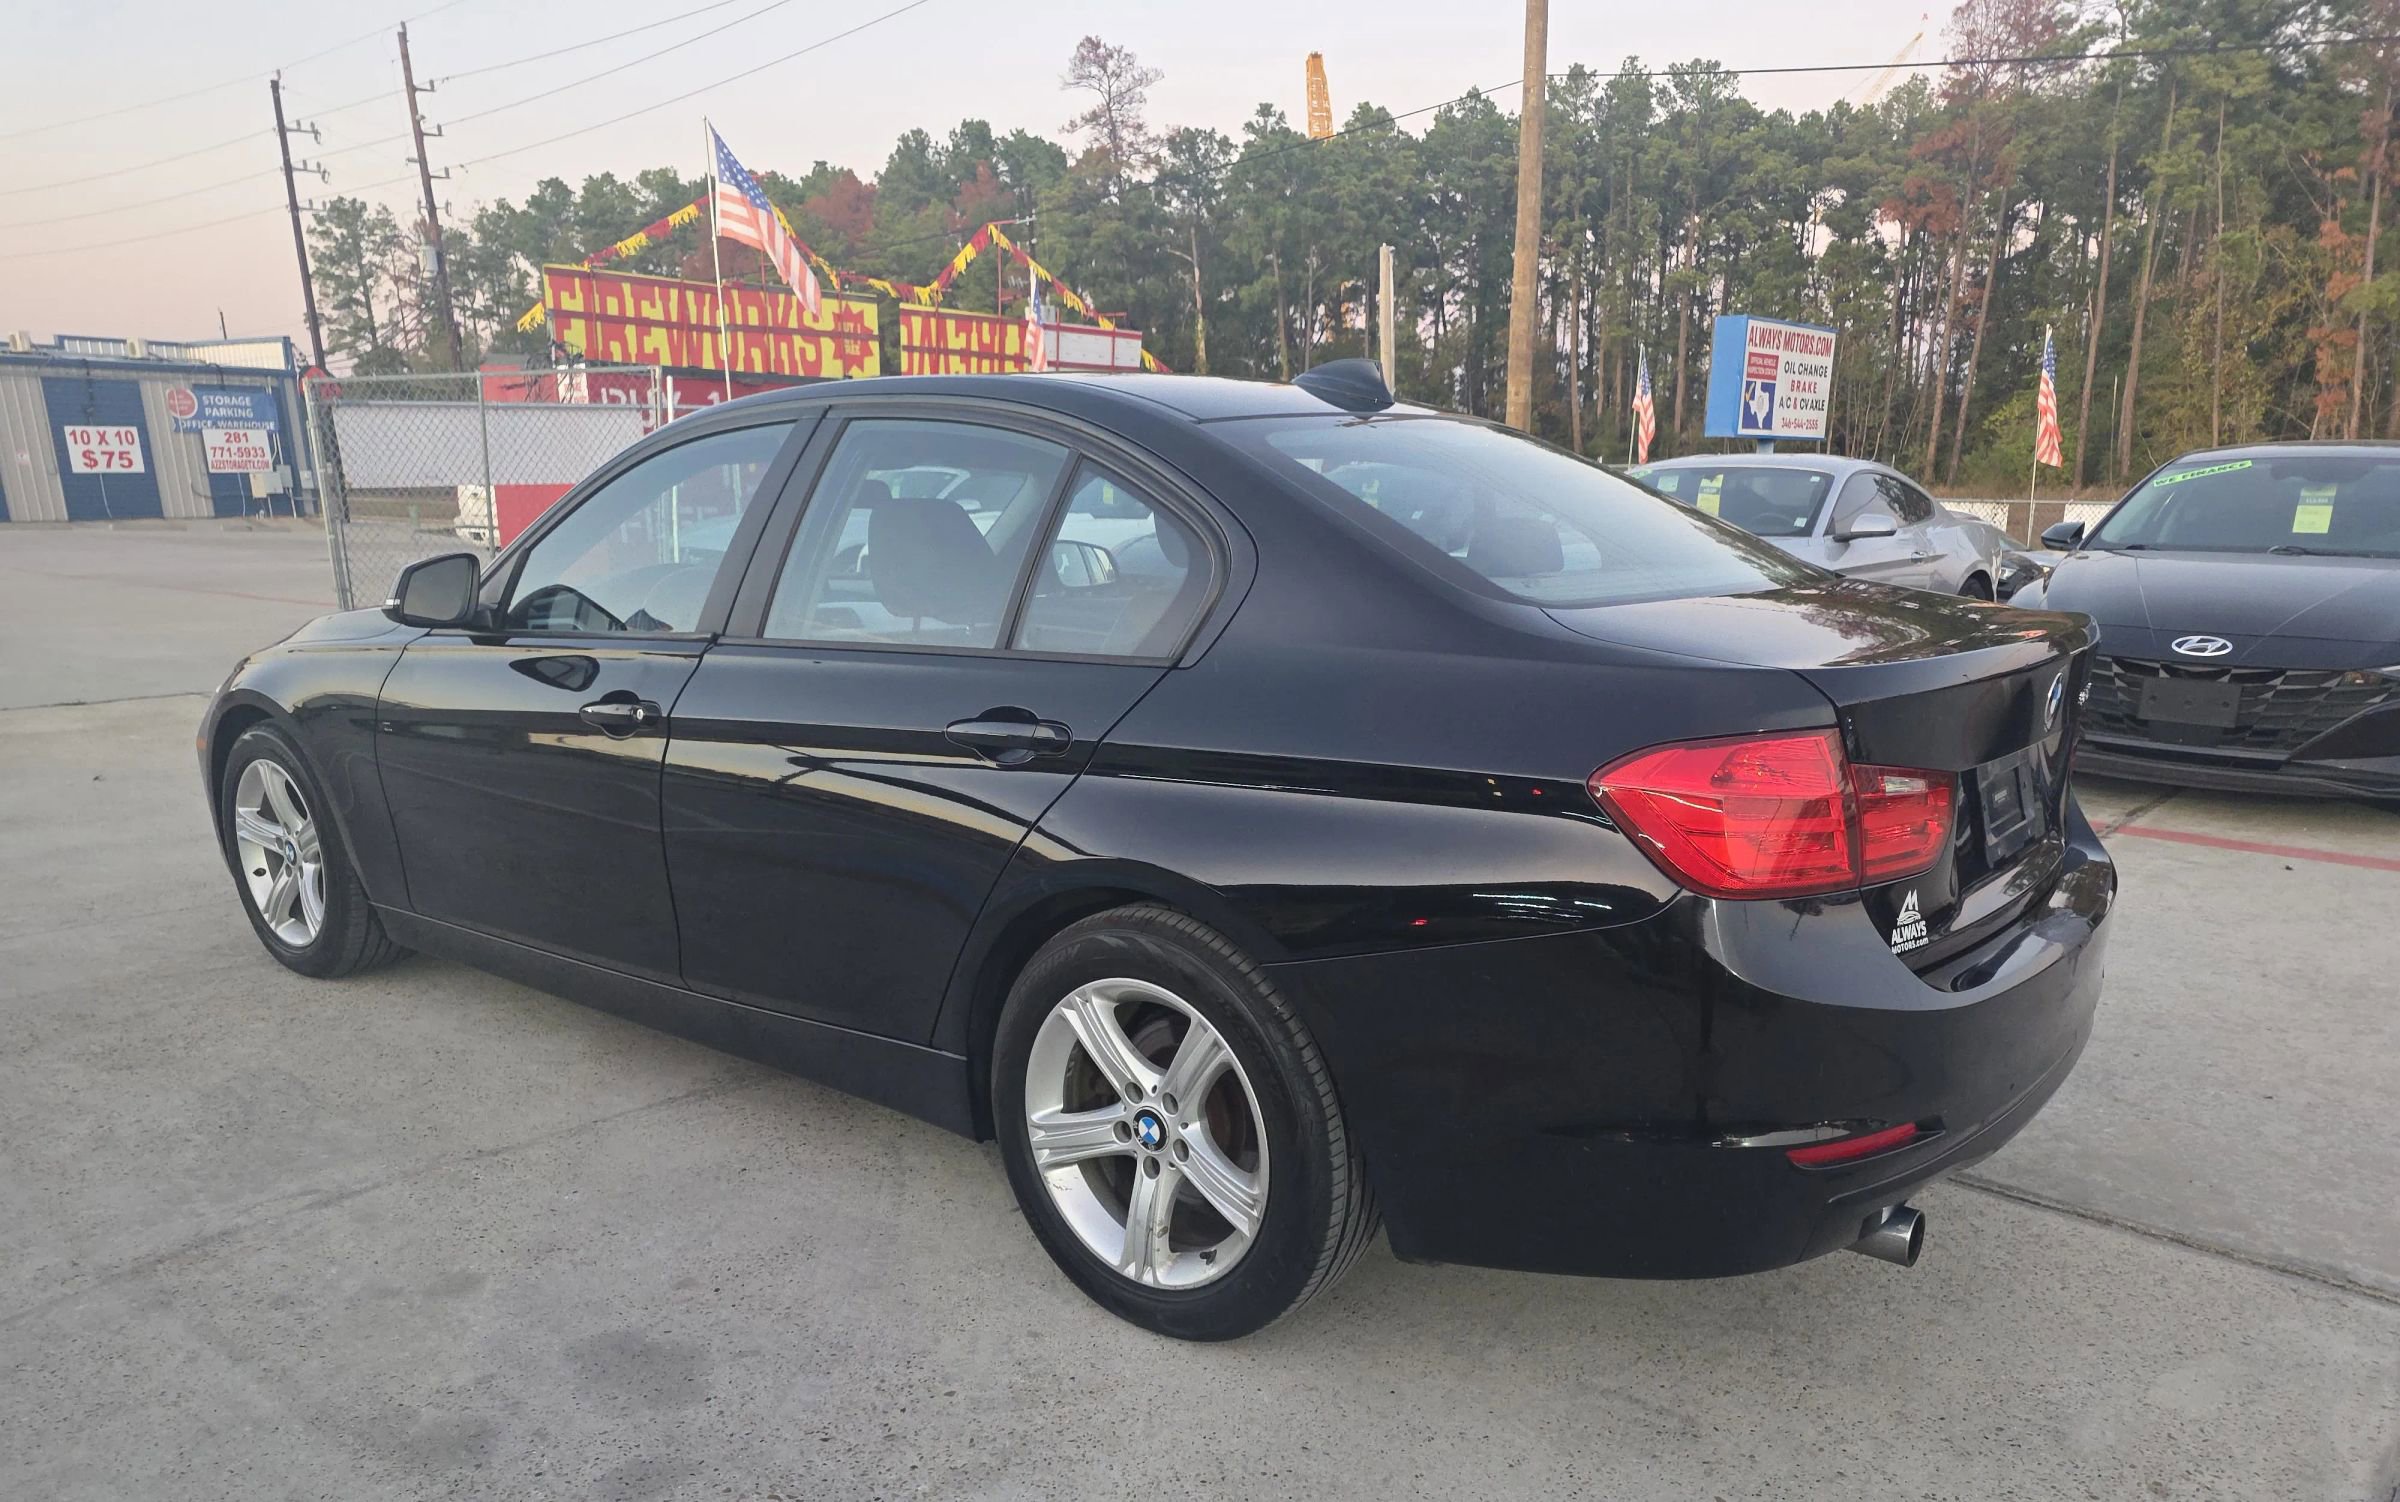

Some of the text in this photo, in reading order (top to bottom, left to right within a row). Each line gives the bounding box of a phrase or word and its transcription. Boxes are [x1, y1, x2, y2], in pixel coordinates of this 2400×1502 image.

[547, 271, 822, 377] FIREWORKS
[1748, 325, 1833, 358] ALWAYS MOTORS.COM
[1784, 360, 1828, 378] OIL CHANGE
[1790, 379, 1817, 394] BRAKE
[202, 395, 252, 407] STORAGE
[1792, 397, 1798, 410] &
[204, 407, 254, 418] PARKING
[219, 419, 275, 430] WAREHOUSE
[69, 429, 135, 446] 10 X 10
[223, 431, 249, 443] 281
[81, 449, 134, 470] $75
[210, 446, 266, 458] 771-5933
[2155, 461, 2249, 485] WE FINANCE
[1891, 920, 1927, 945] ALWAYS
[1891, 937, 1929, 955] MOTORS.com
